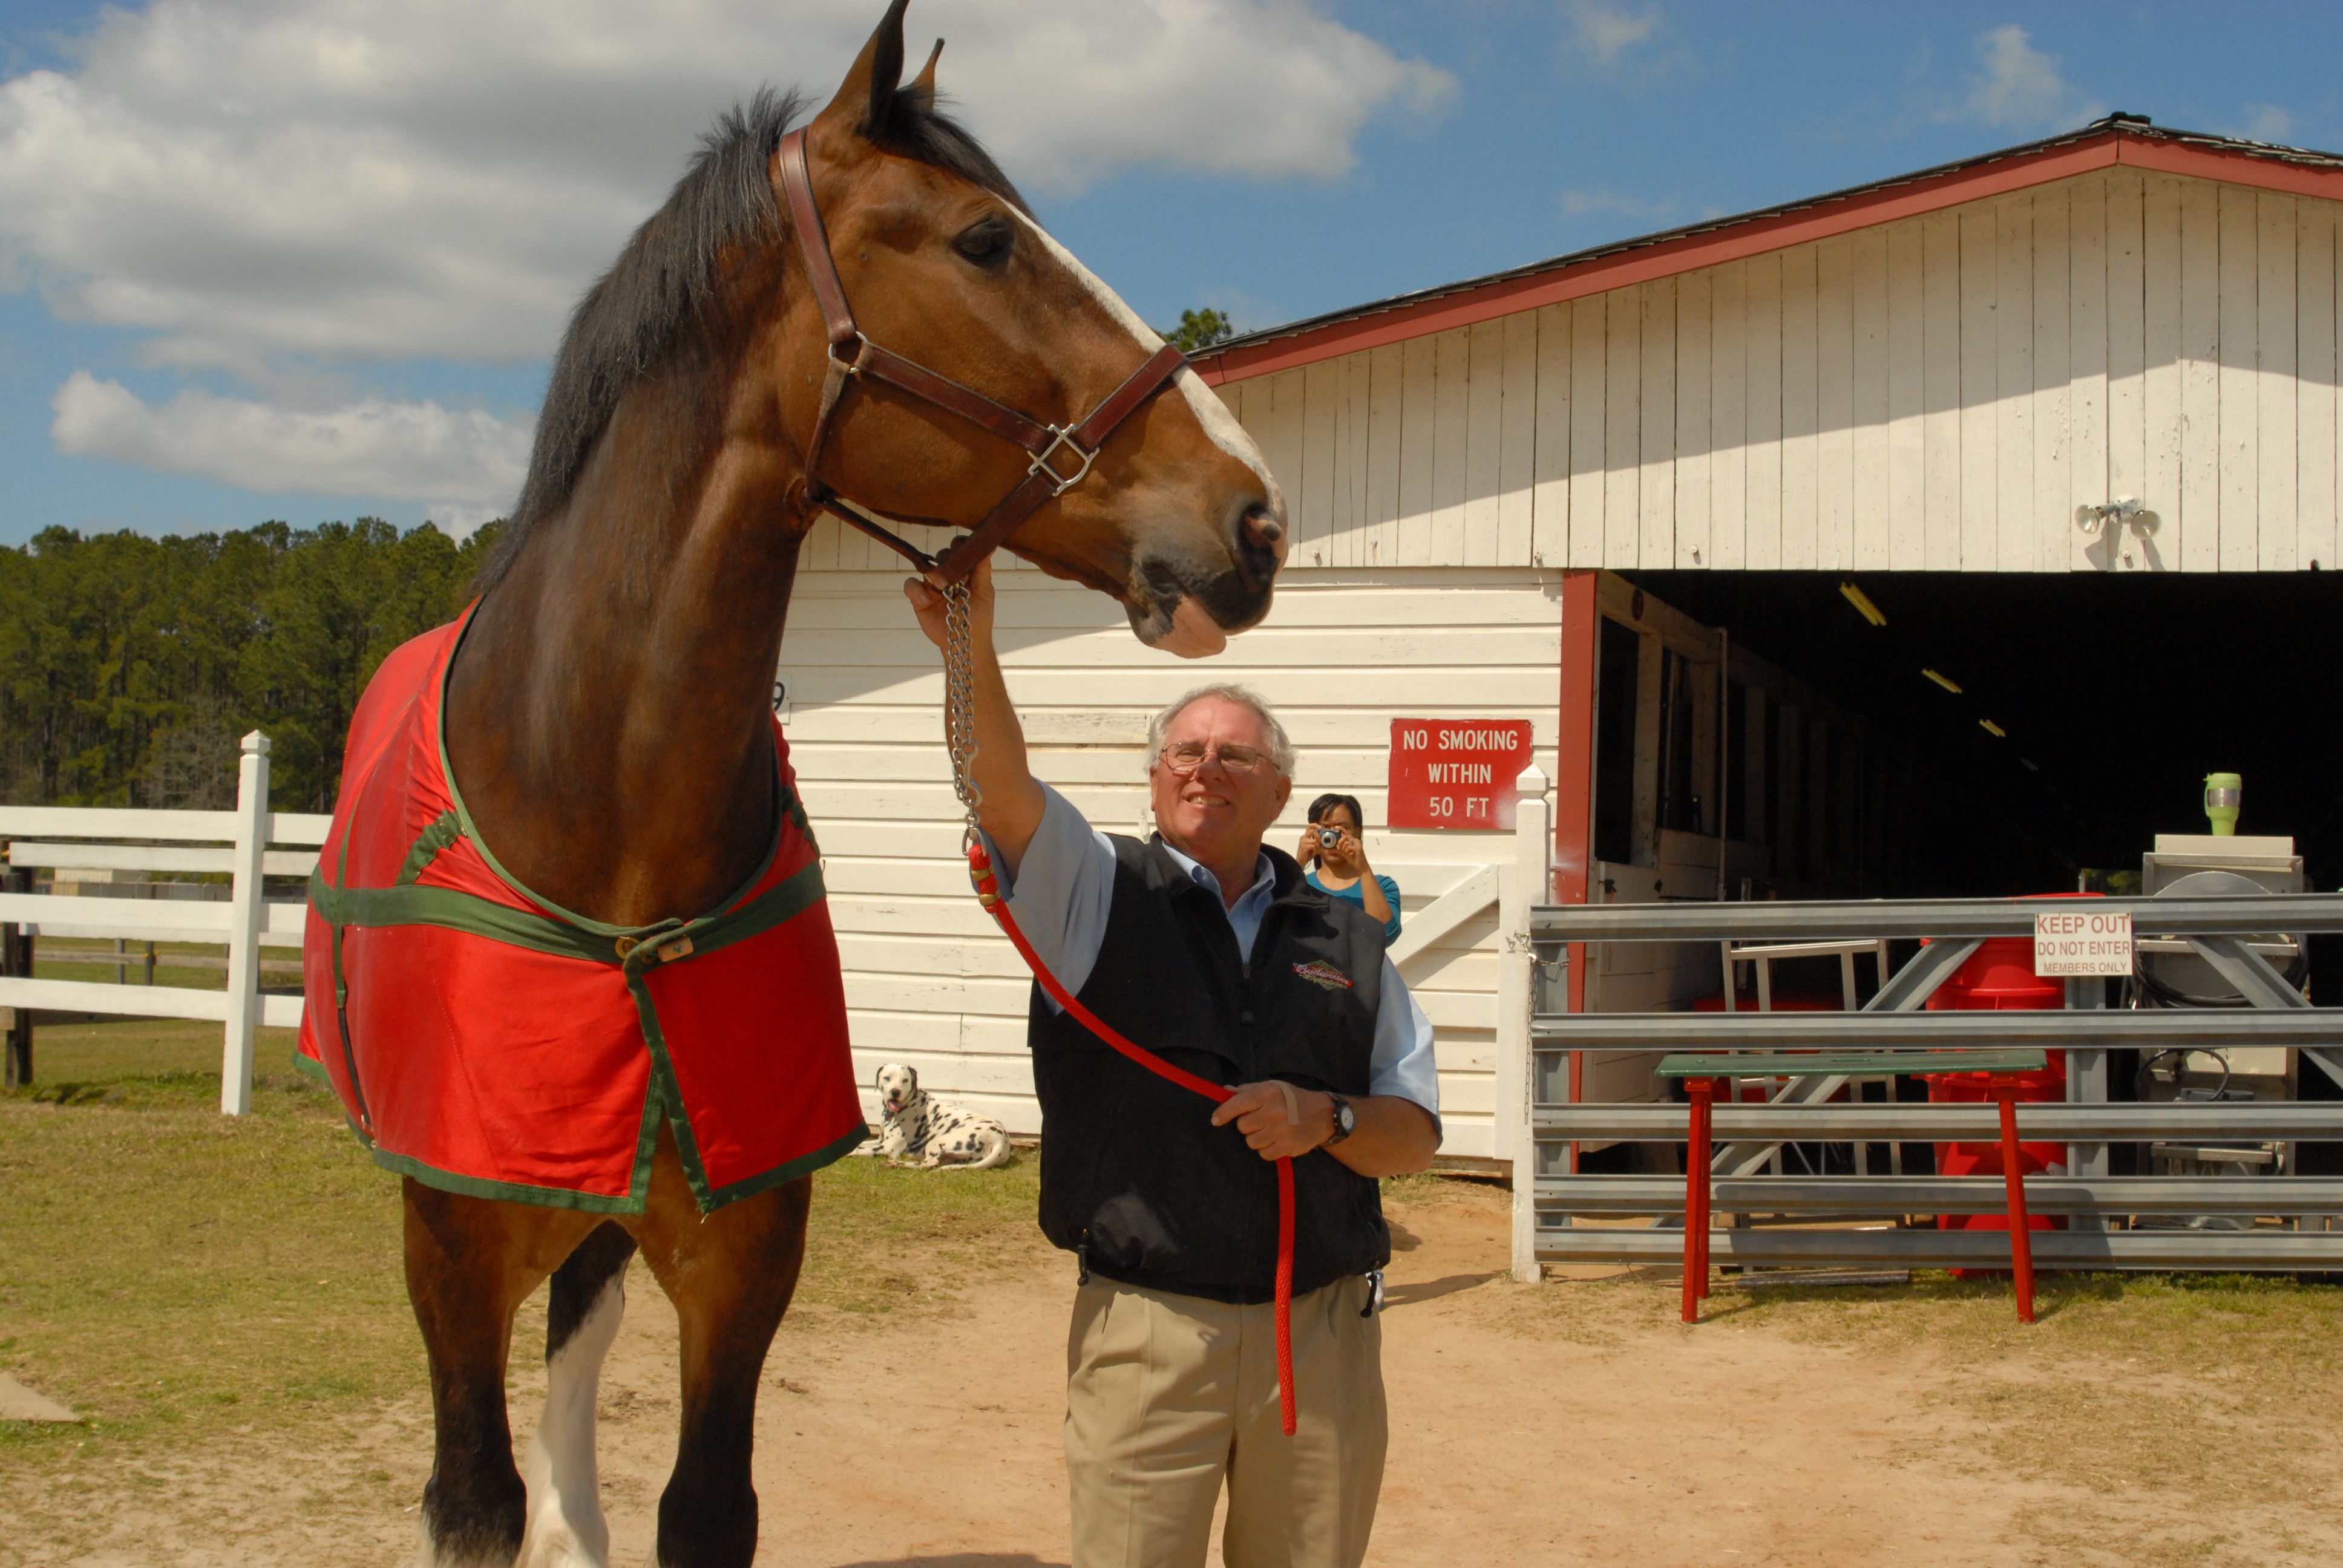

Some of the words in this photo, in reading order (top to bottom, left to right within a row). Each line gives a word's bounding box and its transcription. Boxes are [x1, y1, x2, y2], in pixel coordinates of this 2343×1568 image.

[1403, 730, 1428, 750] NO
[1438, 730, 1518, 751] SMOKING
[1428, 763, 1492, 784] WITHIN
[1430, 796, 1453, 817] 50
[1466, 797, 1489, 817] FT
[2036, 916, 2085, 934] KEEP
[2091, 915, 2129, 933] OUT
[2037, 941, 2056, 956] DO
[2060, 941, 2085, 956] NOT
[2089, 941, 2130, 955] ENTER
[1293, 962, 1349, 985] Budweiser
[2043, 962, 2096, 973] MEMBERS
[2099, 962, 2127, 973] ONLY
